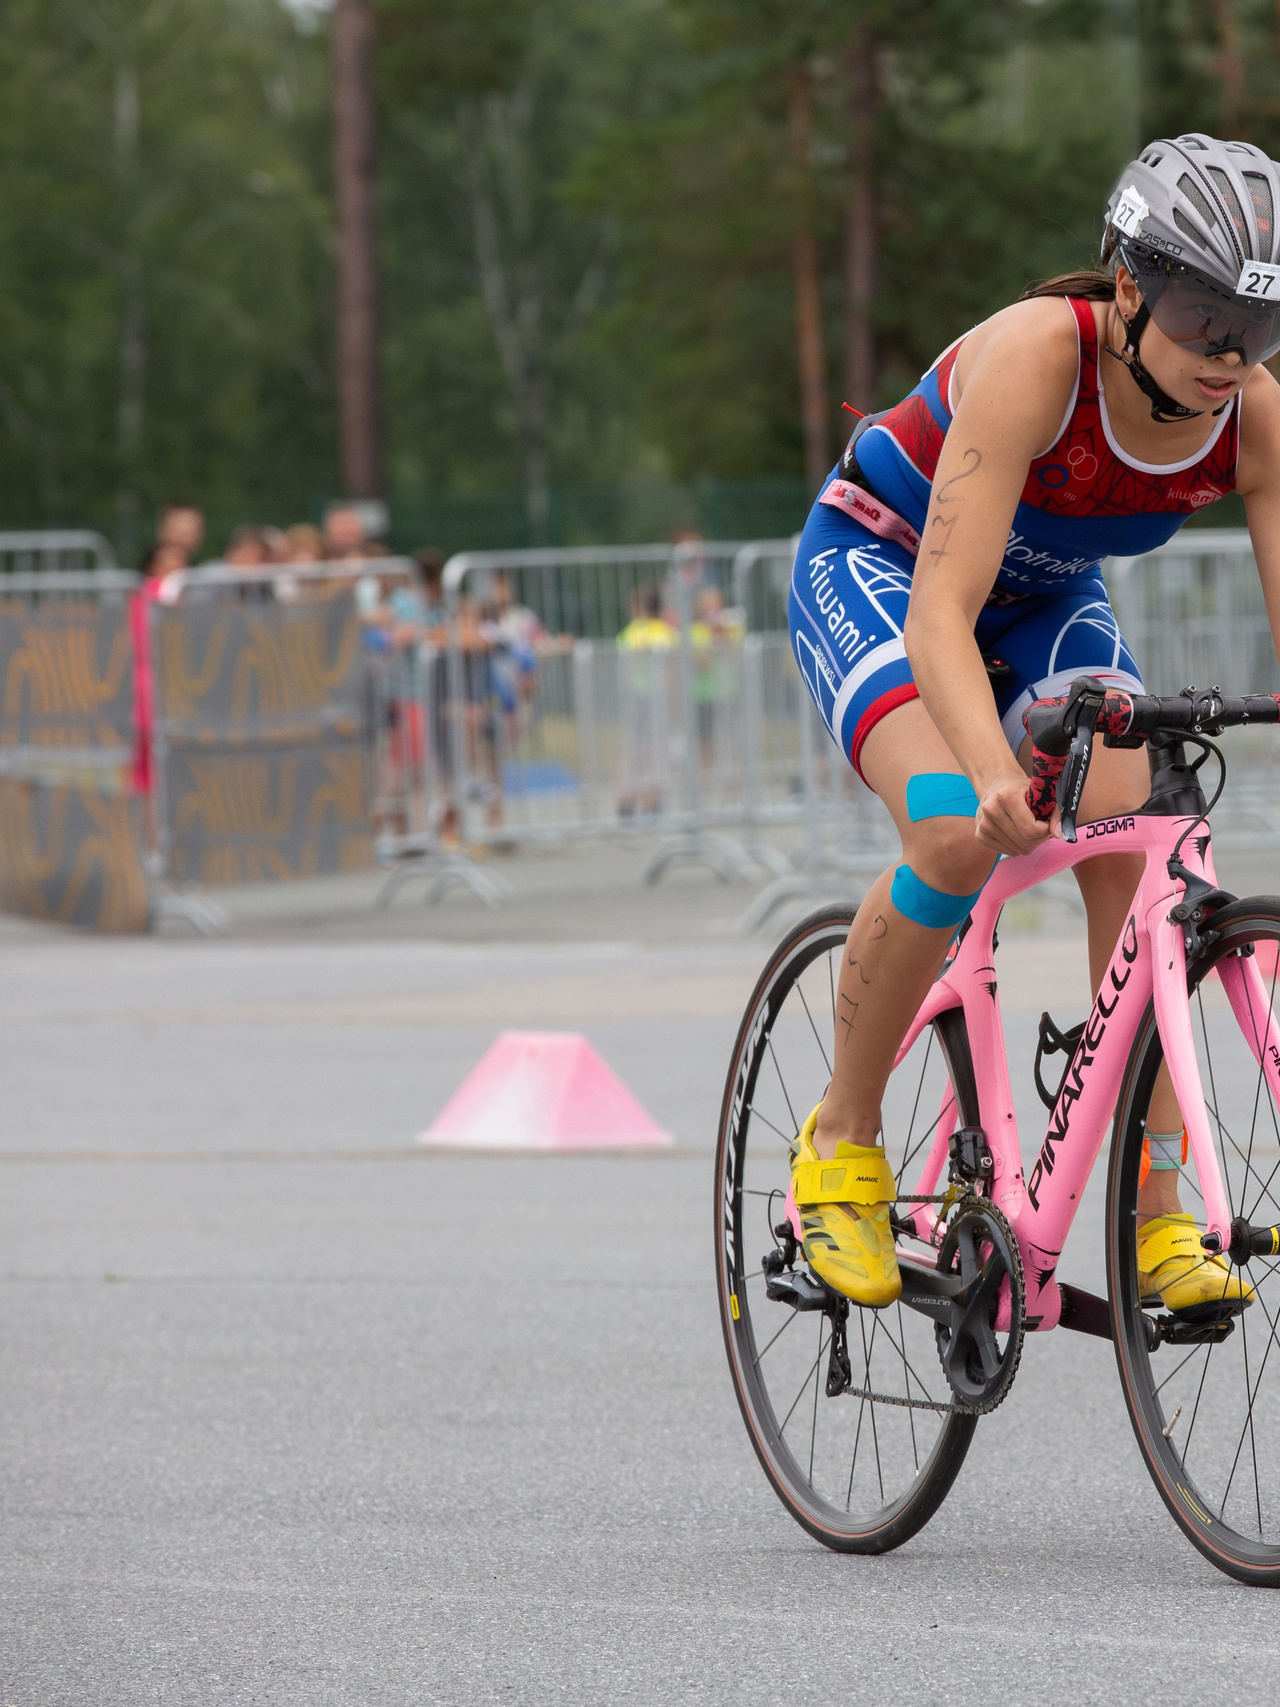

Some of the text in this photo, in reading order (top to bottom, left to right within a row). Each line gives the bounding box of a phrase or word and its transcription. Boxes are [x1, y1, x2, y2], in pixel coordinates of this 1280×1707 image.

[1116, 202, 1135, 228] 27
[1245, 272, 1276, 295] 27
[1063, 491, 1077, 502] ITU
[808, 547, 877, 663] kiwami
[1071, 744, 1089, 811] ULTEGRA
[1086, 817, 1135, 839] DOGMA
[1028, 914, 1139, 1213] PINARELLO
[855, 1175, 879, 1184] MAVIC
[1170, 1236, 1194, 1246] MAVIC
[911, 1296, 951, 1307] ULTEGRA
